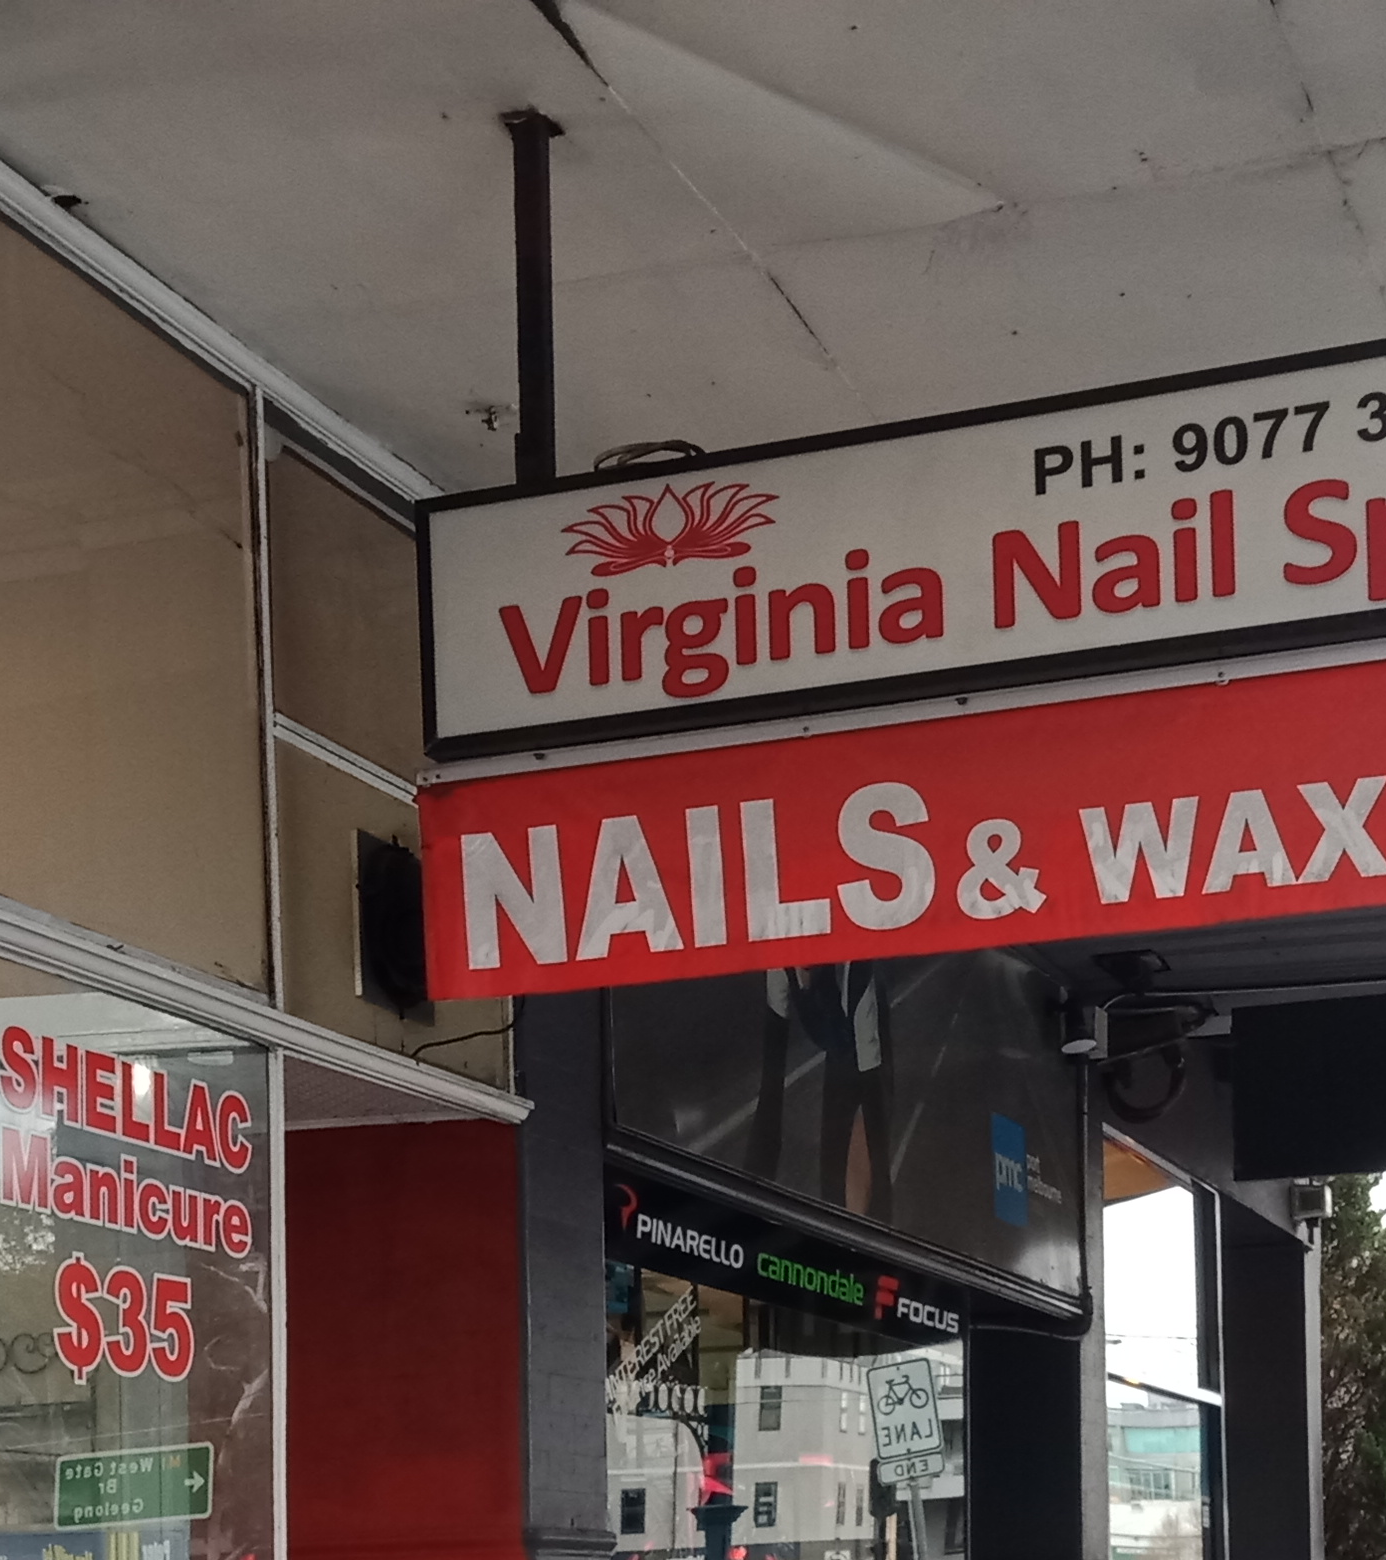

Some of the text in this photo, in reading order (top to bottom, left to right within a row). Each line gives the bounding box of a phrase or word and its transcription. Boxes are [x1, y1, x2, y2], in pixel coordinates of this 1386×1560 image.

[1034, 430, 1146, 497] PH:
[1172, 401, 1330, 472] 9077
[502, 550, 944, 698] Virginia
[994, 490, 1237, 629] Nail
[461, 783, 936, 970] NAILS
[956, 818, 1047, 920] &
[636, 1213, 744, 1269] PINARELLO
[663, 1284, 697, 1337] FREE
[757, 1252, 864, 1305] cannondale
[53, 1253, 196, 1384] $35
[656, 1315, 701, 1379] Available
[897, 1297, 959, 1333] FOCUS
